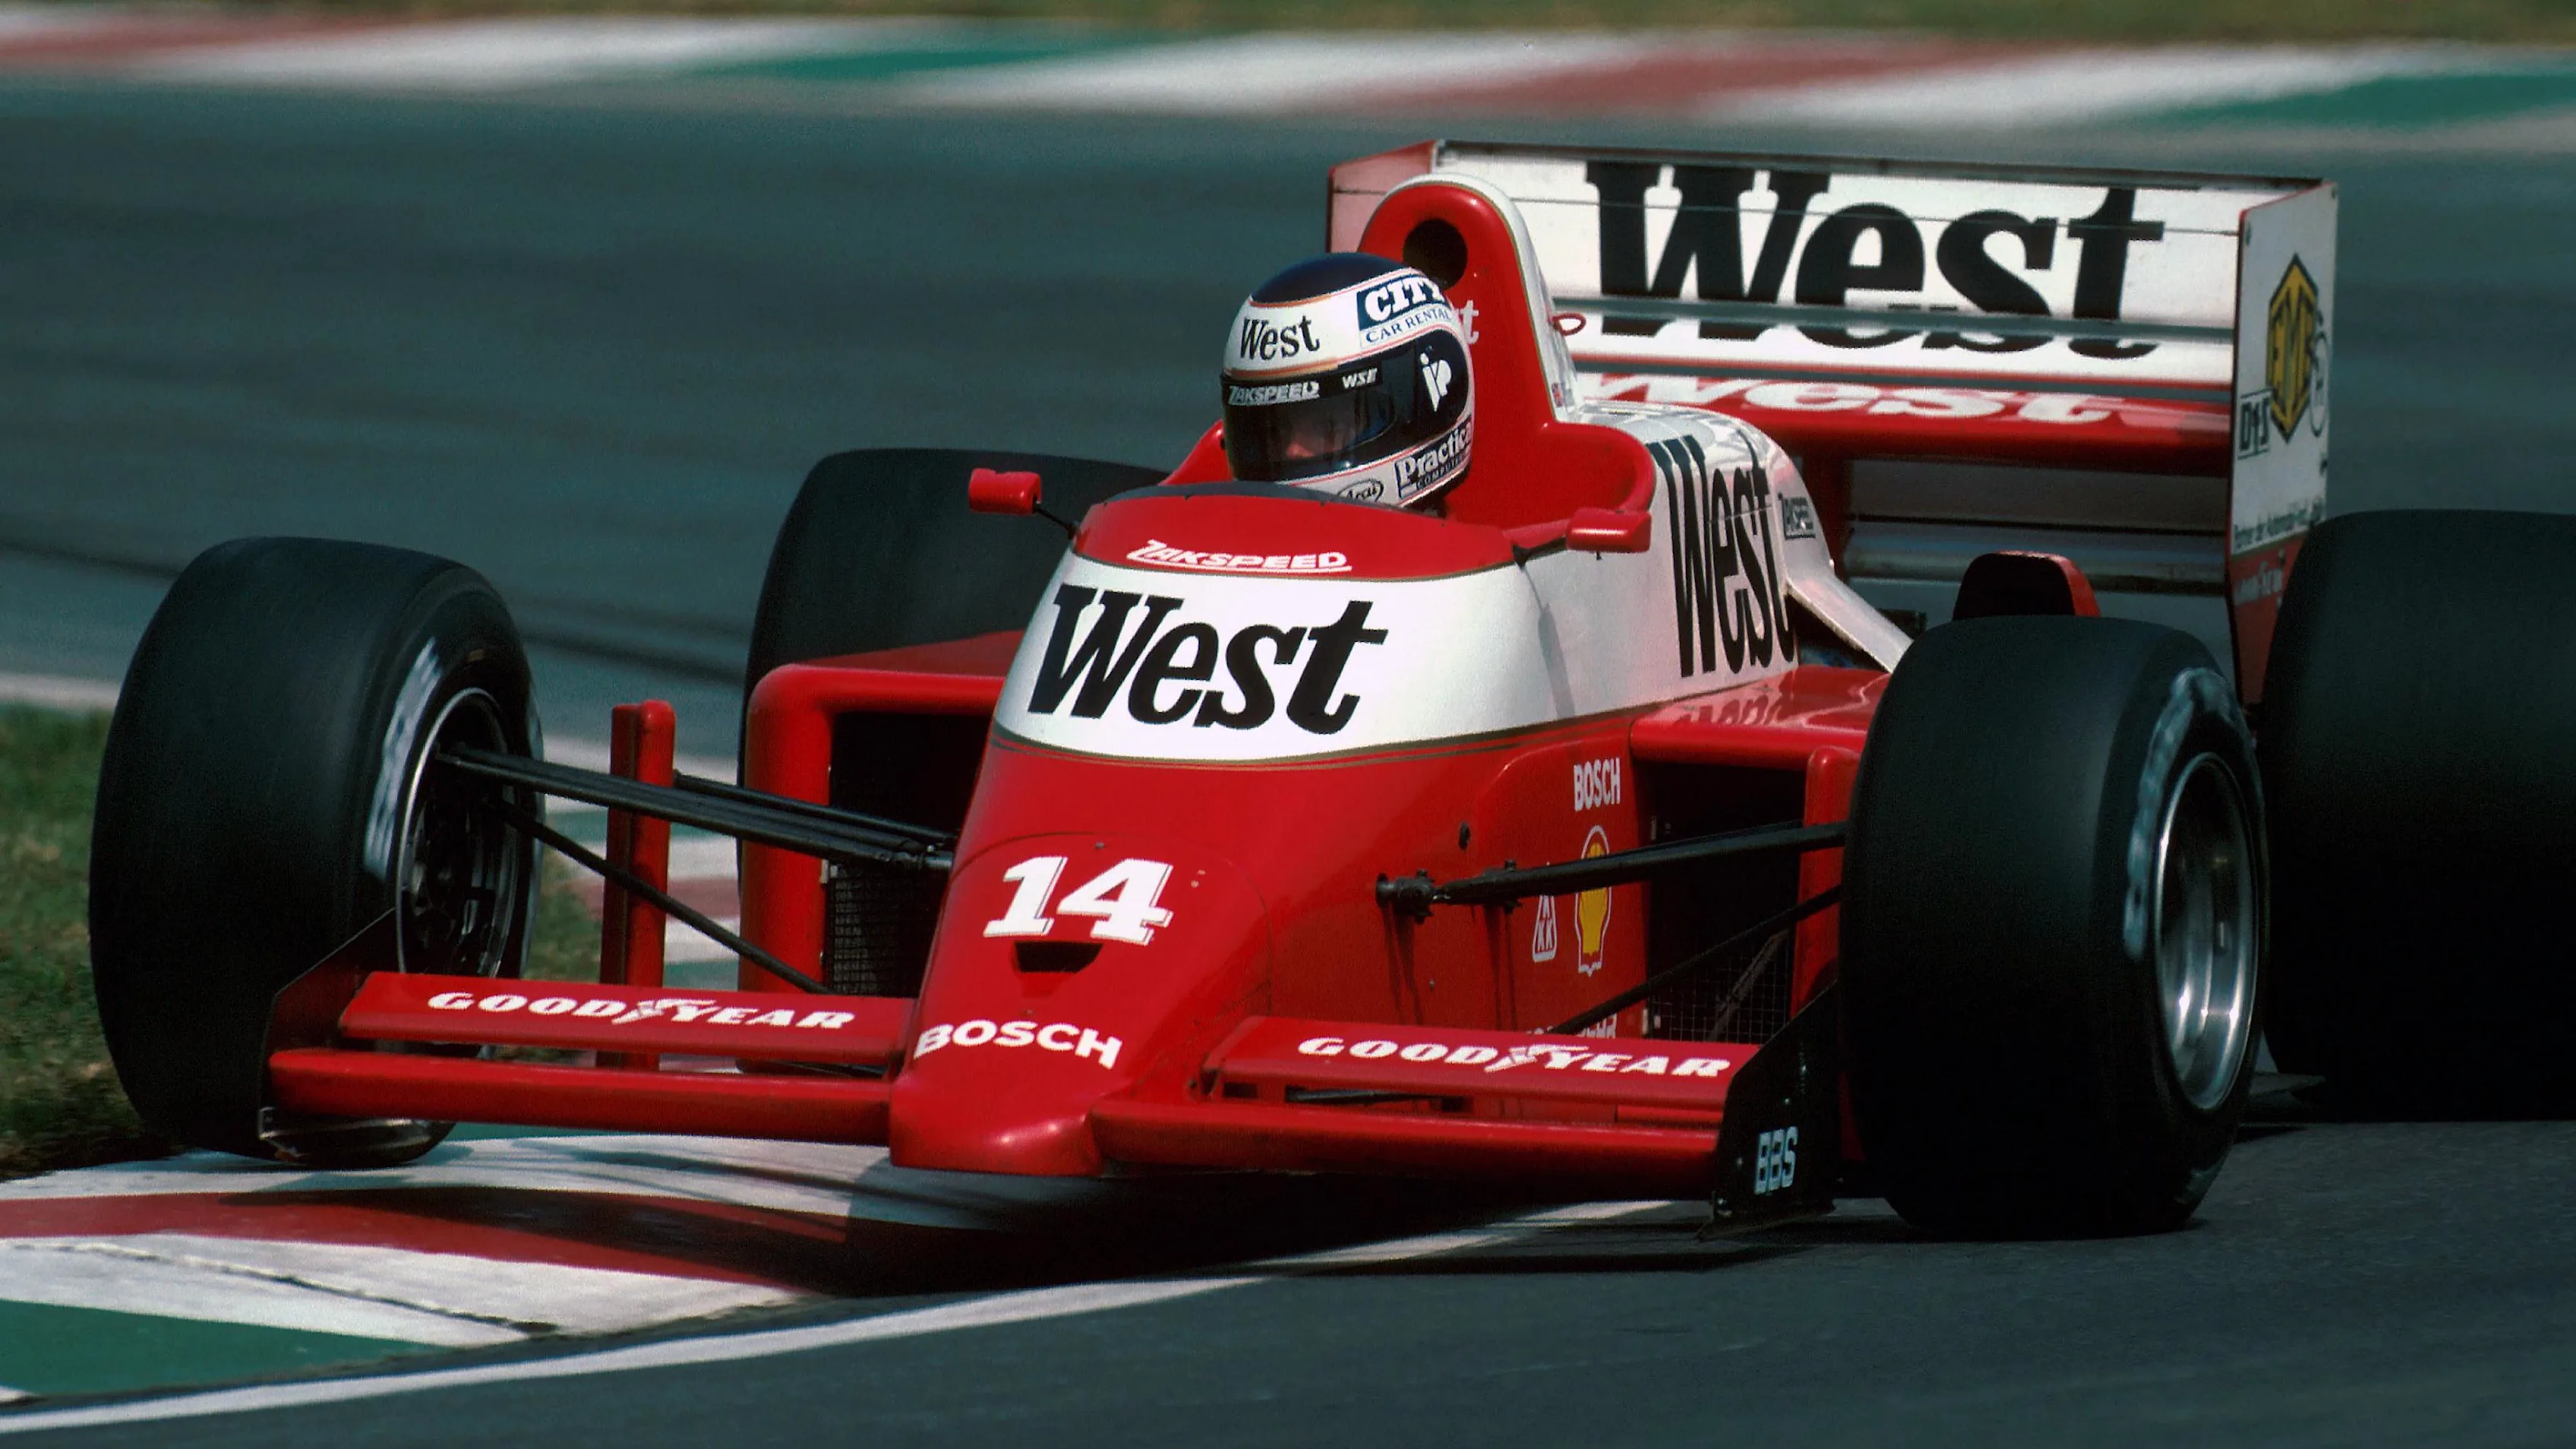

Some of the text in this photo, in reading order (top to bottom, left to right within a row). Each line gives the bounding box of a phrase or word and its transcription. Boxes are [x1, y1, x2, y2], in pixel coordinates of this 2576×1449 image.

[1586, 160, 2166, 360] West
[1365, 277, 1445, 322] CITY
[1240, 314, 1320, 361] West
[1365, 322, 1403, 343] CAR
[1405, 308, 1453, 330] RENTAL
[1126, 539, 1352, 573] ZAKSPEED
[1646, 430, 1795, 678] West
[1028, 583, 1389, 735] West
[1574, 757, 1621, 812] BOSCH
[983, 856, 1174, 946] 14
[428, 991, 855, 1030] GOODYEAR
[914, 1019, 1122, 1069] BOSCH
[1297, 1037, 1732, 1078] GOODYEAR
[1754, 1126, 1798, 1195] BBS
